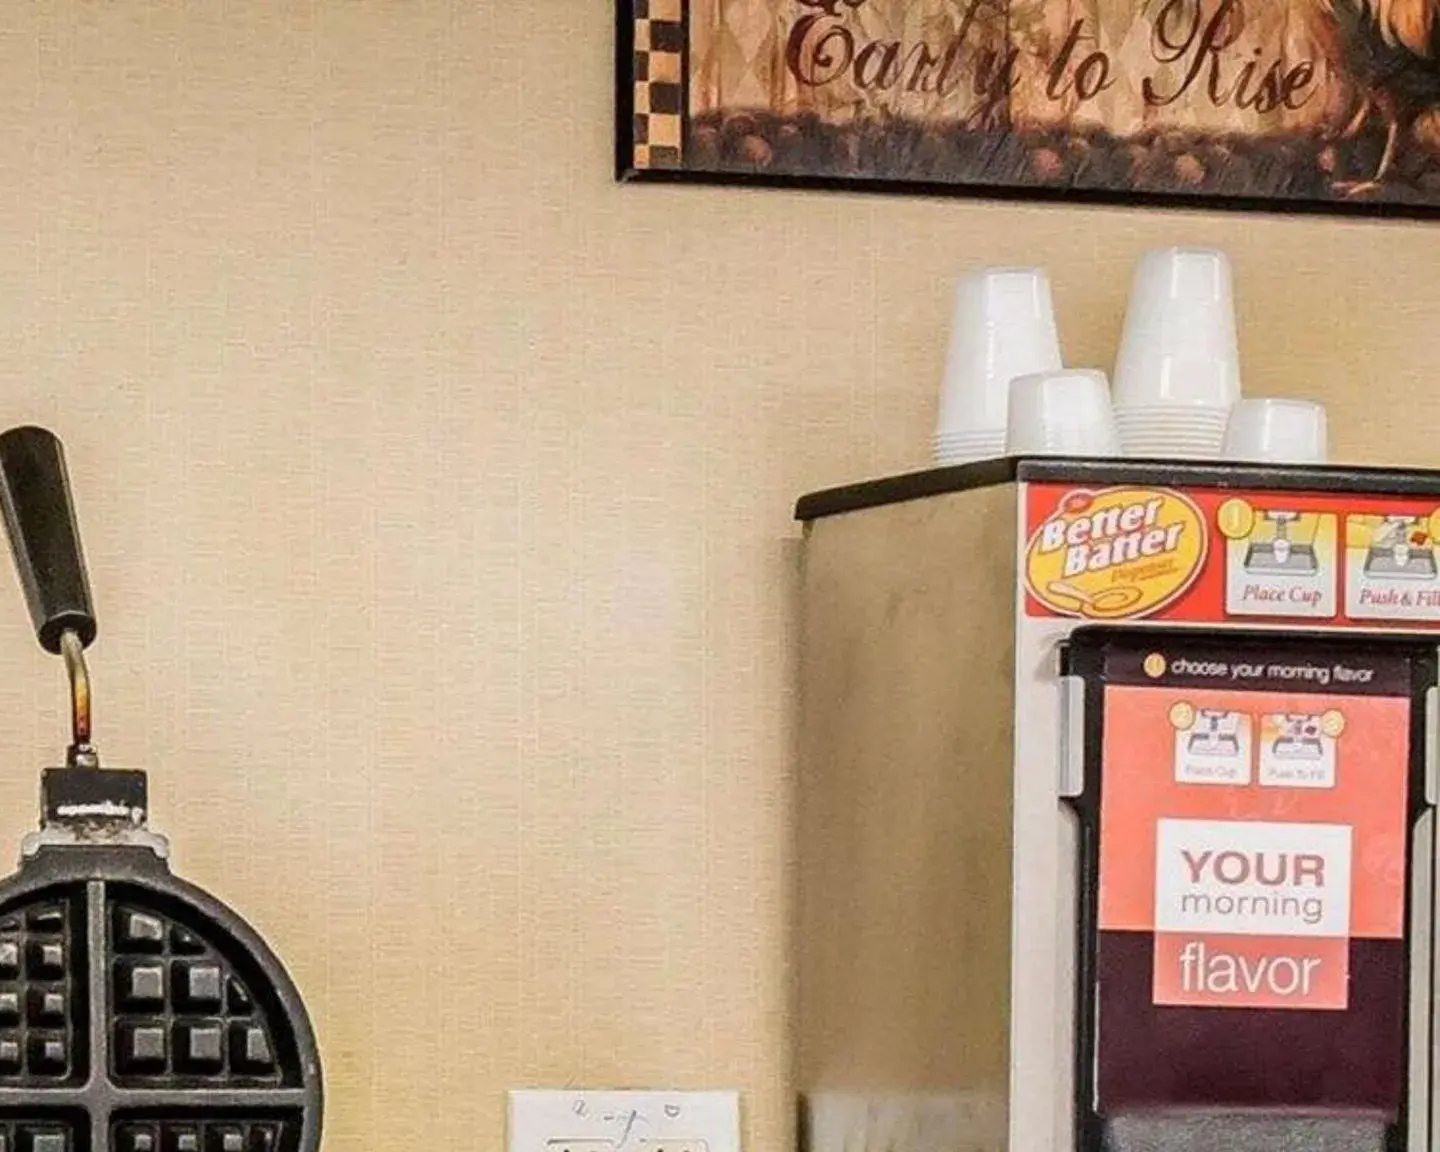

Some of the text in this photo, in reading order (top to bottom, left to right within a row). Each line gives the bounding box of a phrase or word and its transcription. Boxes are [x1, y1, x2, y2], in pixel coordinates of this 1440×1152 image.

[786, 0, 1319, 132] Early to Rise
[1243, 583, 1323, 608] Place Cup
[1359, 587, 1399, 605] Push
[1171, 659, 1228, 675] choose
[1230, 663, 1263, 679] your
[1267, 662, 1330, 684] morning
[1333, 665, 1374, 682] flavor
[1180, 850, 1326, 888] YOUR
[1180, 889, 1324, 925] morning
[1179, 942, 1322, 995] flavor
